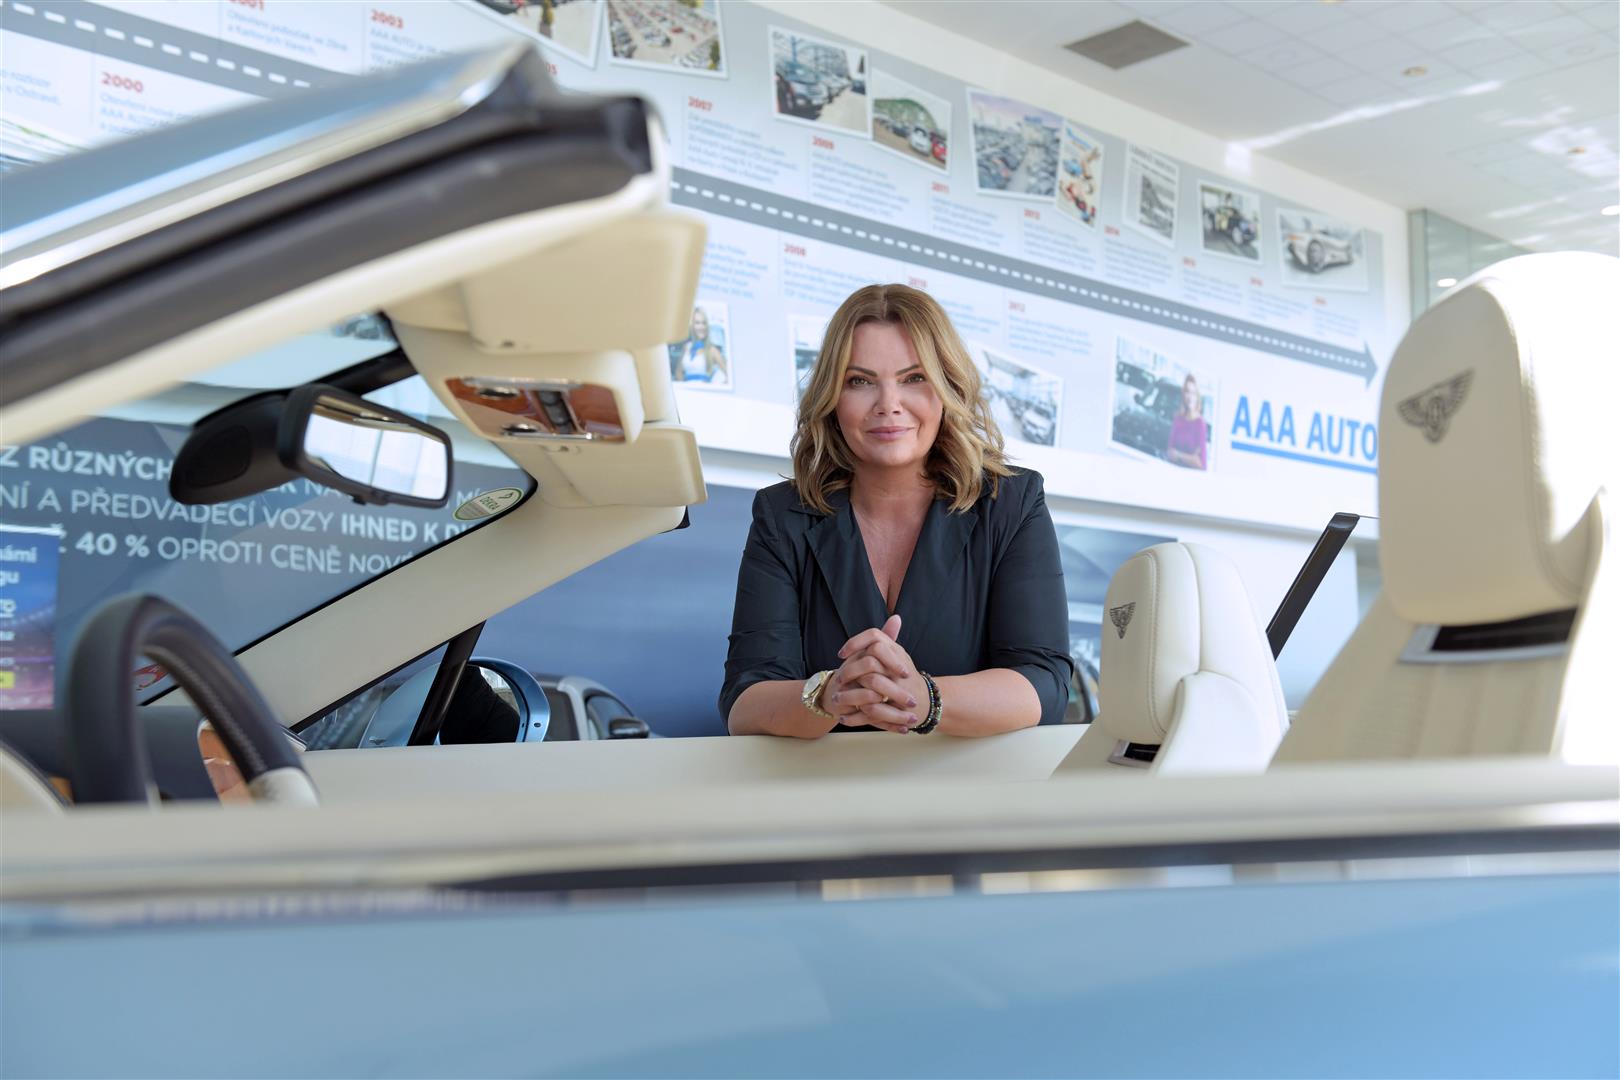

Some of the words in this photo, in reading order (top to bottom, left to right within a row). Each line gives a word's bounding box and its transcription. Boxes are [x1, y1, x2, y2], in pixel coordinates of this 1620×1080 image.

[370, 8, 405, 29] 2003
[101, 71, 145, 94] 2000
[1231, 394, 1296, 447] AAA
[1306, 411, 1378, 462] AUTO
[29, 442, 174, 481] RŮZNÝCH
[37, 487, 61, 513] A
[263, 507, 334, 532] VOZY
[341, 513, 418, 542] IHNED
[423, 521, 440, 545] K
[75, 530, 118, 556] 40
[125, 534, 150, 558] %
[157, 536, 263, 565] OPROTI
[270, 543, 342, 575] CENĚ
